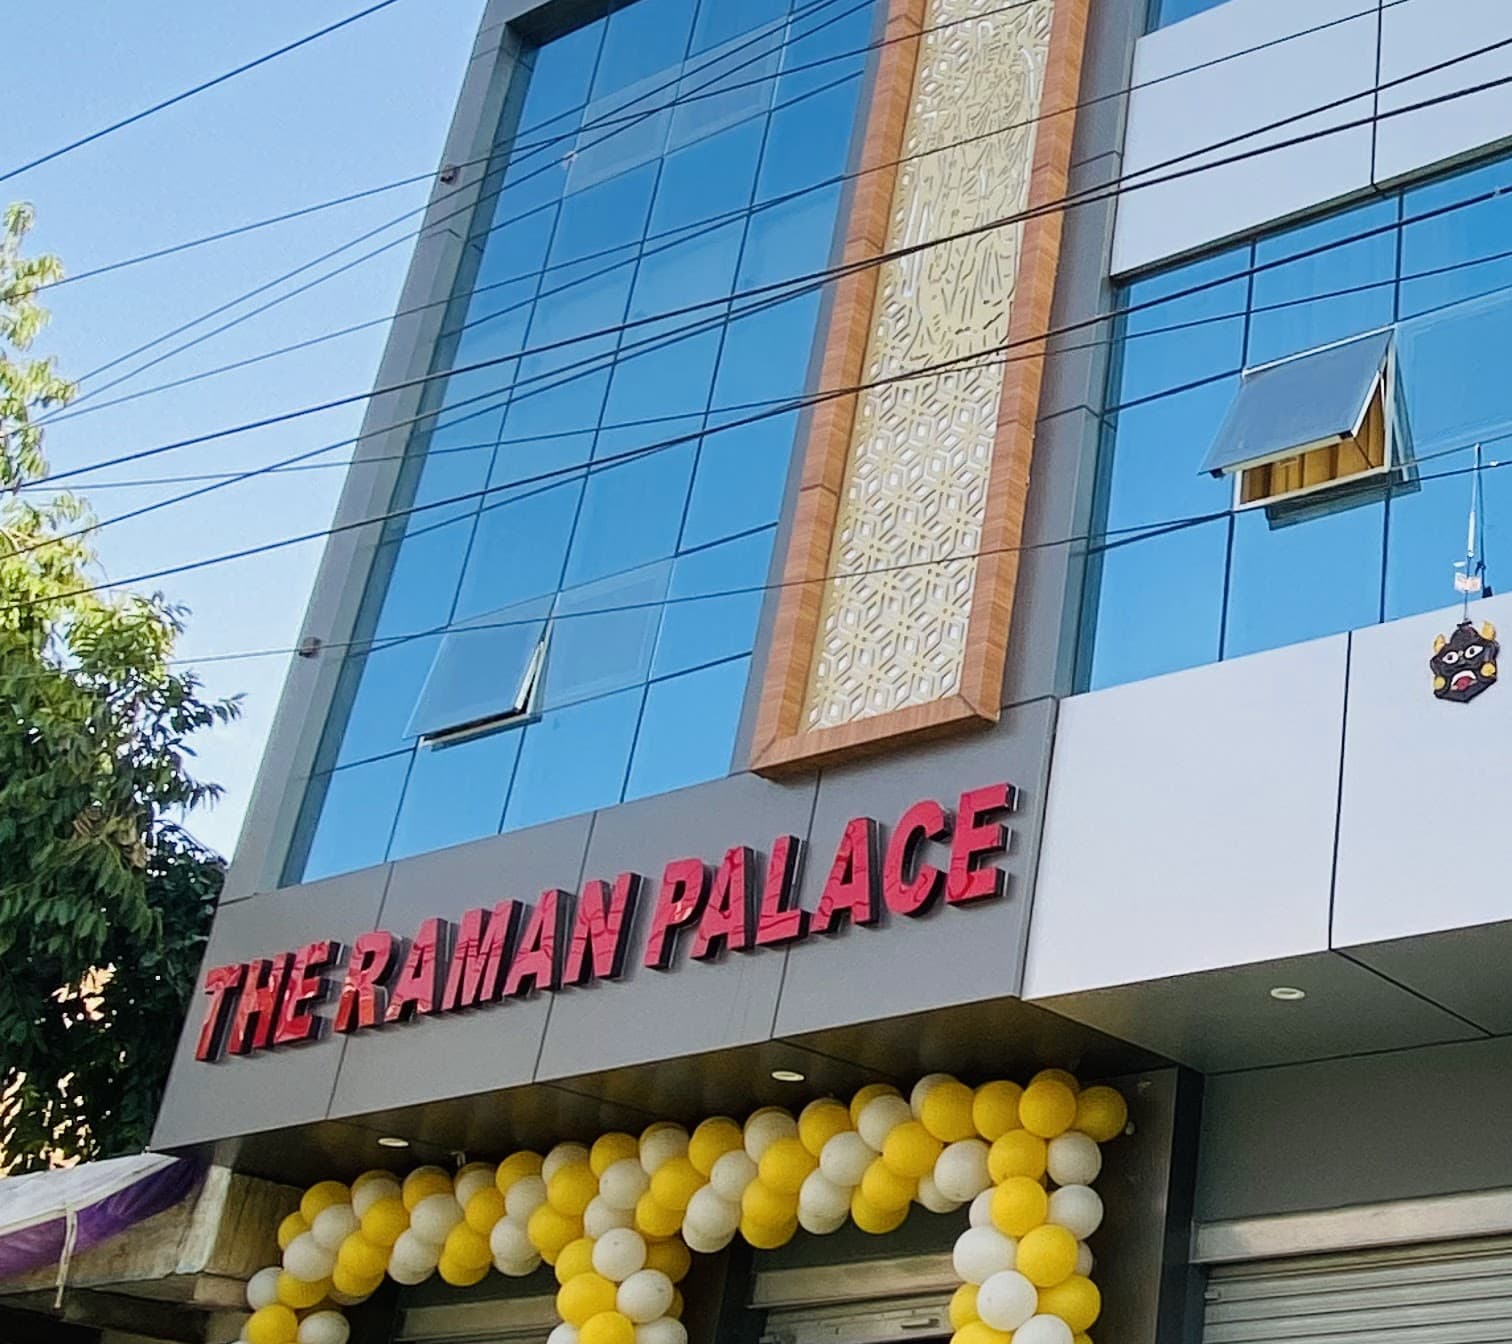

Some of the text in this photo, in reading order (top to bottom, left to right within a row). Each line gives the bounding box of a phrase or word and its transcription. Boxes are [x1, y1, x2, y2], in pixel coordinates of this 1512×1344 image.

[194, 782, 1020, 1062] THE RAMAN PALACE
